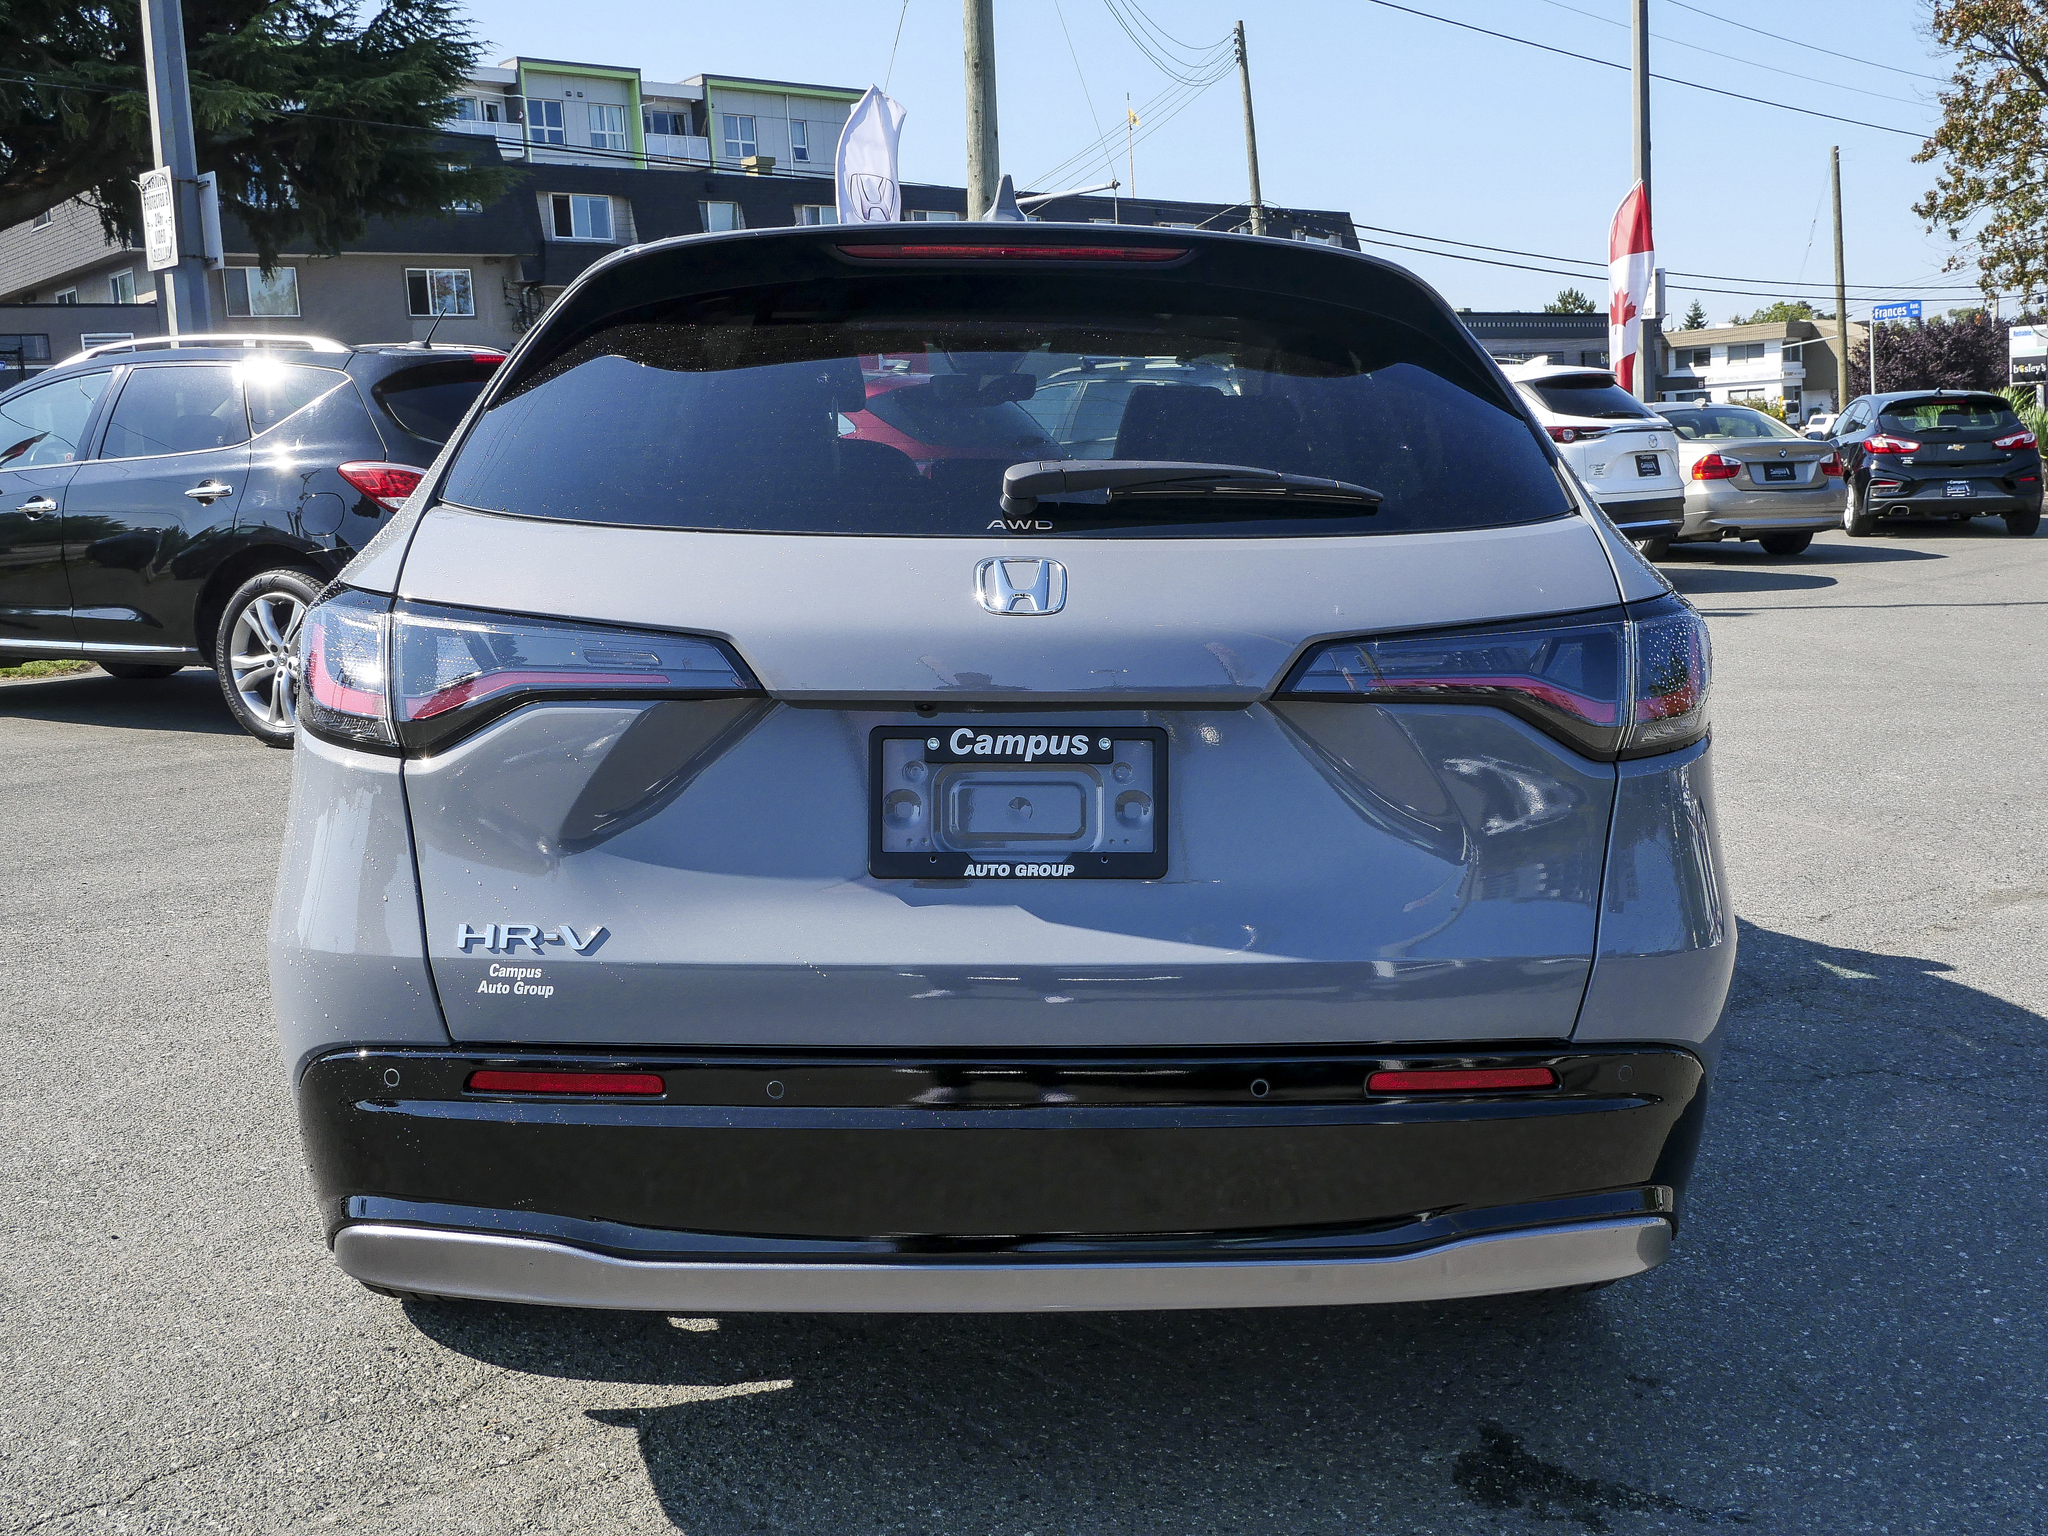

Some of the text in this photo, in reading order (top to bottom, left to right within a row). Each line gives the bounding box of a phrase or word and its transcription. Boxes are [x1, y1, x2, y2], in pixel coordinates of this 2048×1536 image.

[1874, 306, 1907, 319] Frances
[986, 519, 1053, 530] AWD
[948, 727, 1090, 762] Campus
[963, 864, 1075, 877] AUTO GROUP
[457, 923, 604, 952] HR-V
[489, 963, 543, 981] Campus
[477, 980, 555, 999] Auto Group
